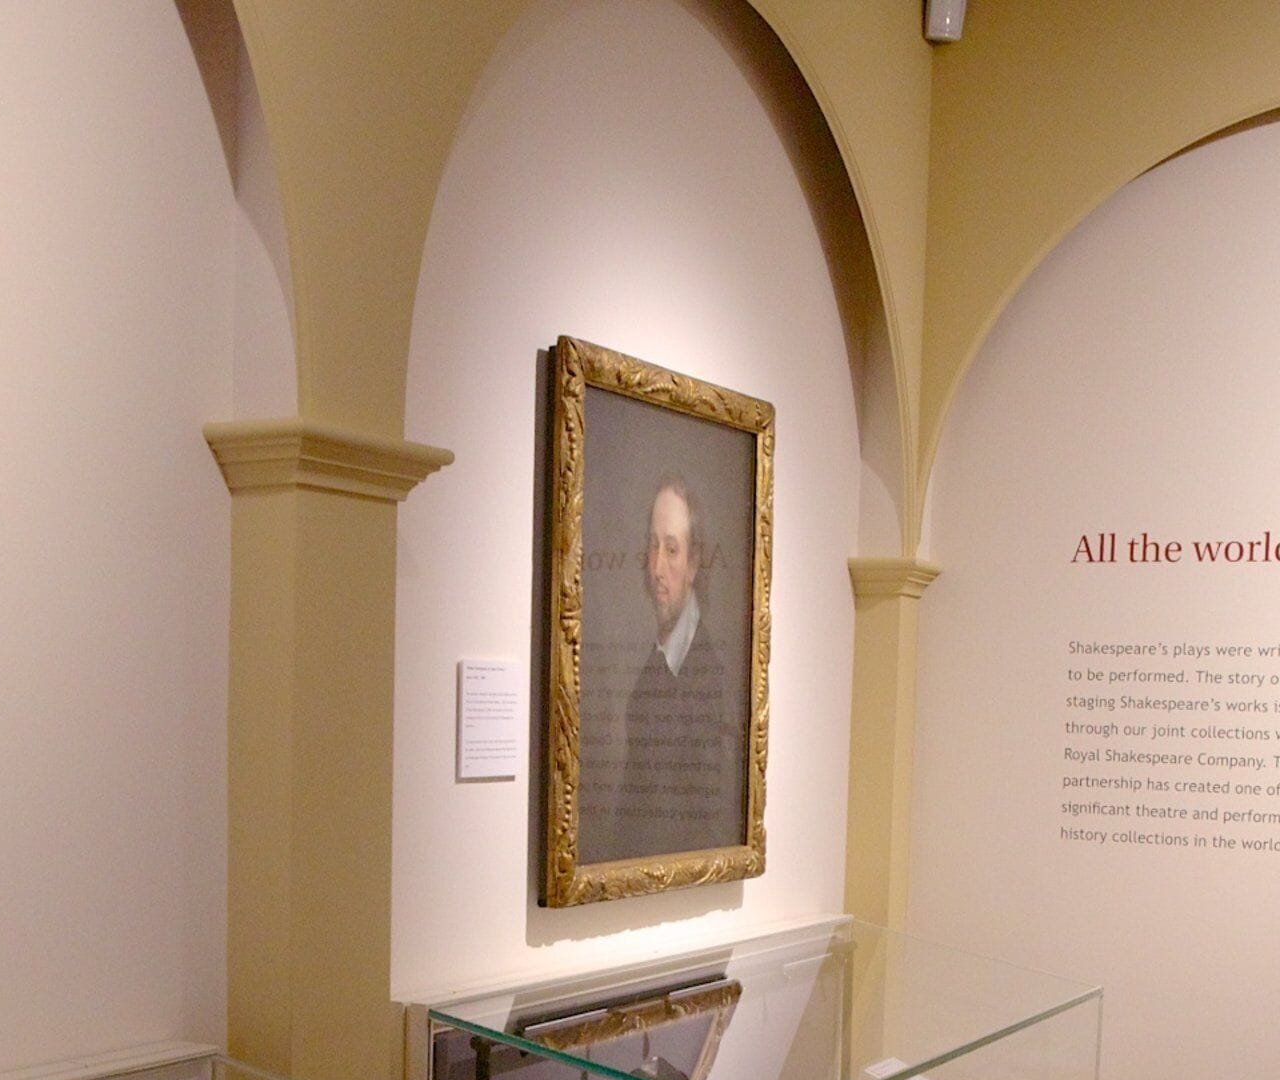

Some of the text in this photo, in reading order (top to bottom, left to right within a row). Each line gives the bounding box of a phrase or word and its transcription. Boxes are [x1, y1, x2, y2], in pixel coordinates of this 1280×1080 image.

[1070, 532, 1117, 564] All
[1127, 531, 1183, 564] the
[1069, 641, 1168, 657] Shakespeare's
[1173, 643, 1210, 659] plays
[1216, 646, 1252, 657] were
[1068, 669, 1082, 681] to
[1087, 668, 1104, 681] be
[1109, 669, 1189, 684] performed.
[1196, 670, 1223, 684] The
[1228, 673, 1265, 687] story
[1066, 696, 1115, 711] staging
[1121, 696, 1220, 712] Shakespeare's
[1226, 699, 1268, 713] works
[1065, 721, 1118, 738] through
[1123, 726, 1146, 736] our
[1151, 725, 1185, 740] joint
[1191, 726, 1270, 740] collections
[1064, 748, 1100, 763] Royal
[1105, 749, 1193, 766] Shakespeare
[1197, 753, 1266, 770] Company.
[1063, 776, 1142, 792] partnership
[1147, 778, 1169, 791] has
[1174, 782, 1230, 794] created
[1235, 785, 1262, 795] one
[1061, 801, 1130, 816] significant
[1136, 804, 1187, 819] theatre
[1192, 808, 1218, 820] and
[1060, 827, 1107, 844] history
[1112, 831, 1189, 846] collections
[1194, 835, 1207, 847] in
[1212, 836, 1236, 849] the
